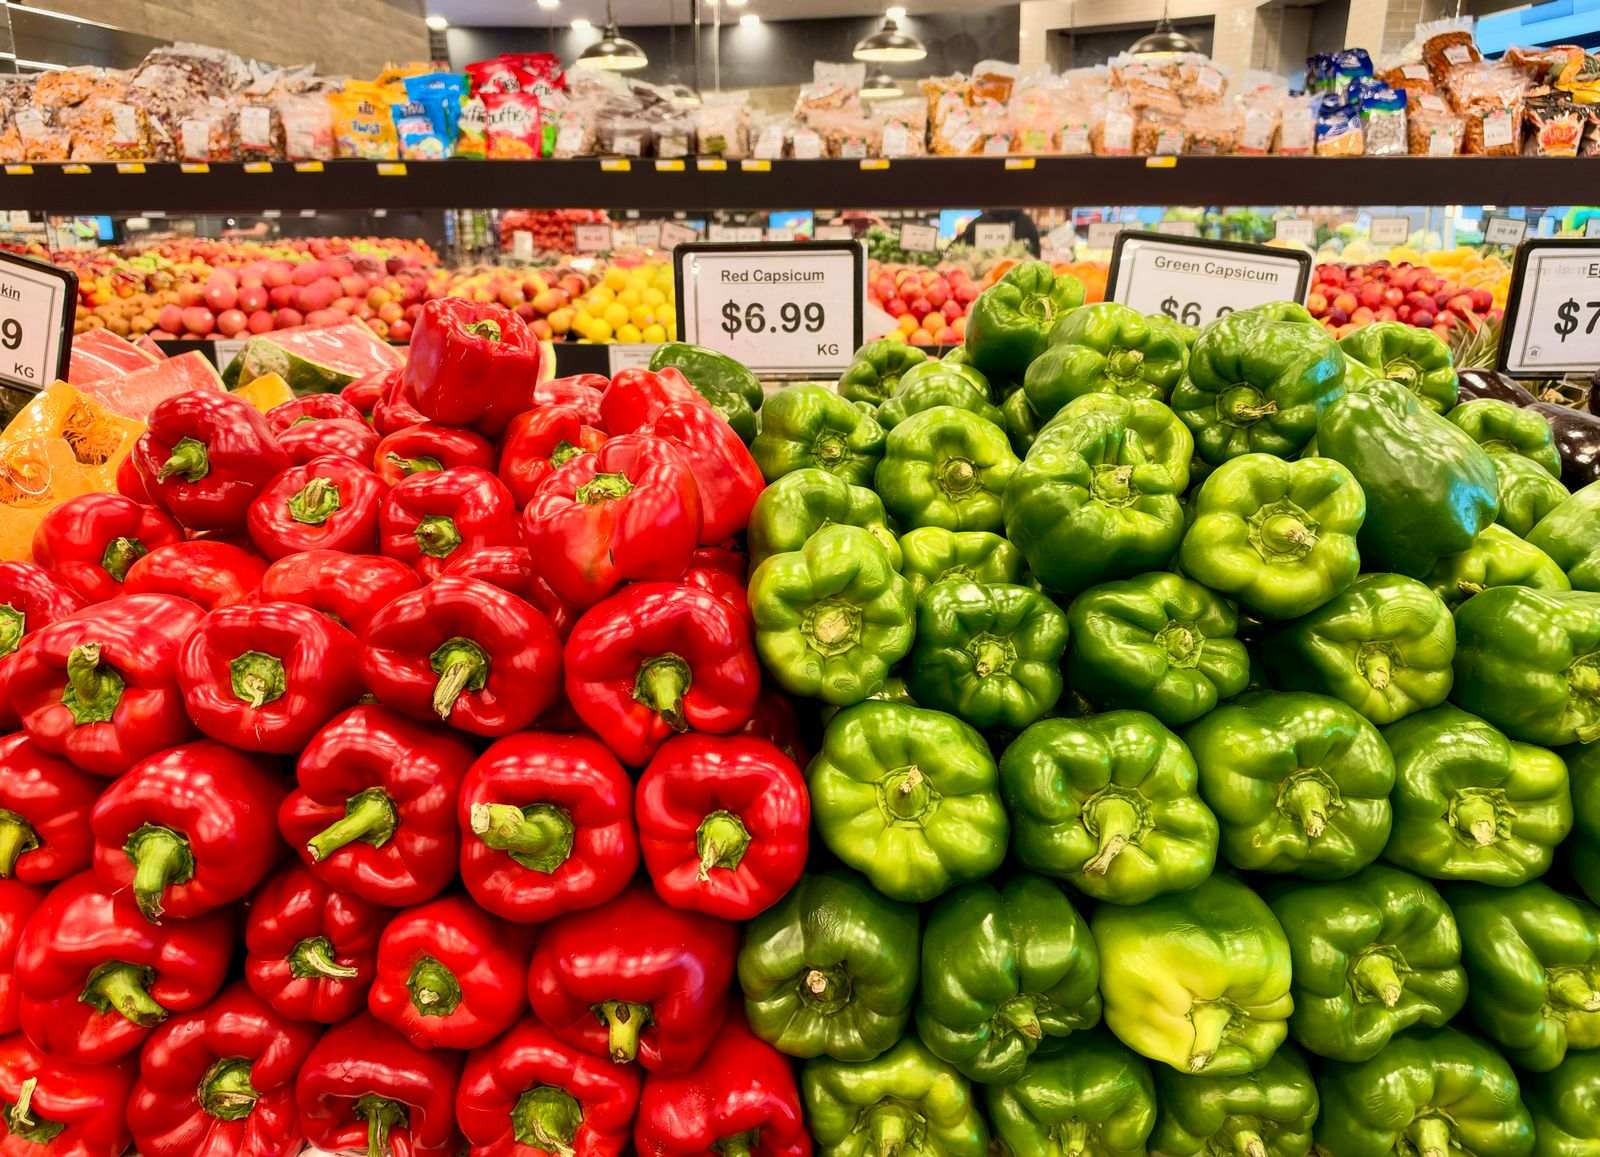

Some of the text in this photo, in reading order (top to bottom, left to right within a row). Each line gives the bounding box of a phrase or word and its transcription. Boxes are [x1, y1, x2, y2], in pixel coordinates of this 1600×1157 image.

[721, 269, 825, 284] Red Capsicum
[1154, 255, 1279, 283] Green Capsicum
[0, 283, 21, 301] kin
[721, 299, 825, 341] $6.99
[817, 343, 839, 356] KG
[14, 362, 35, 379] KG
